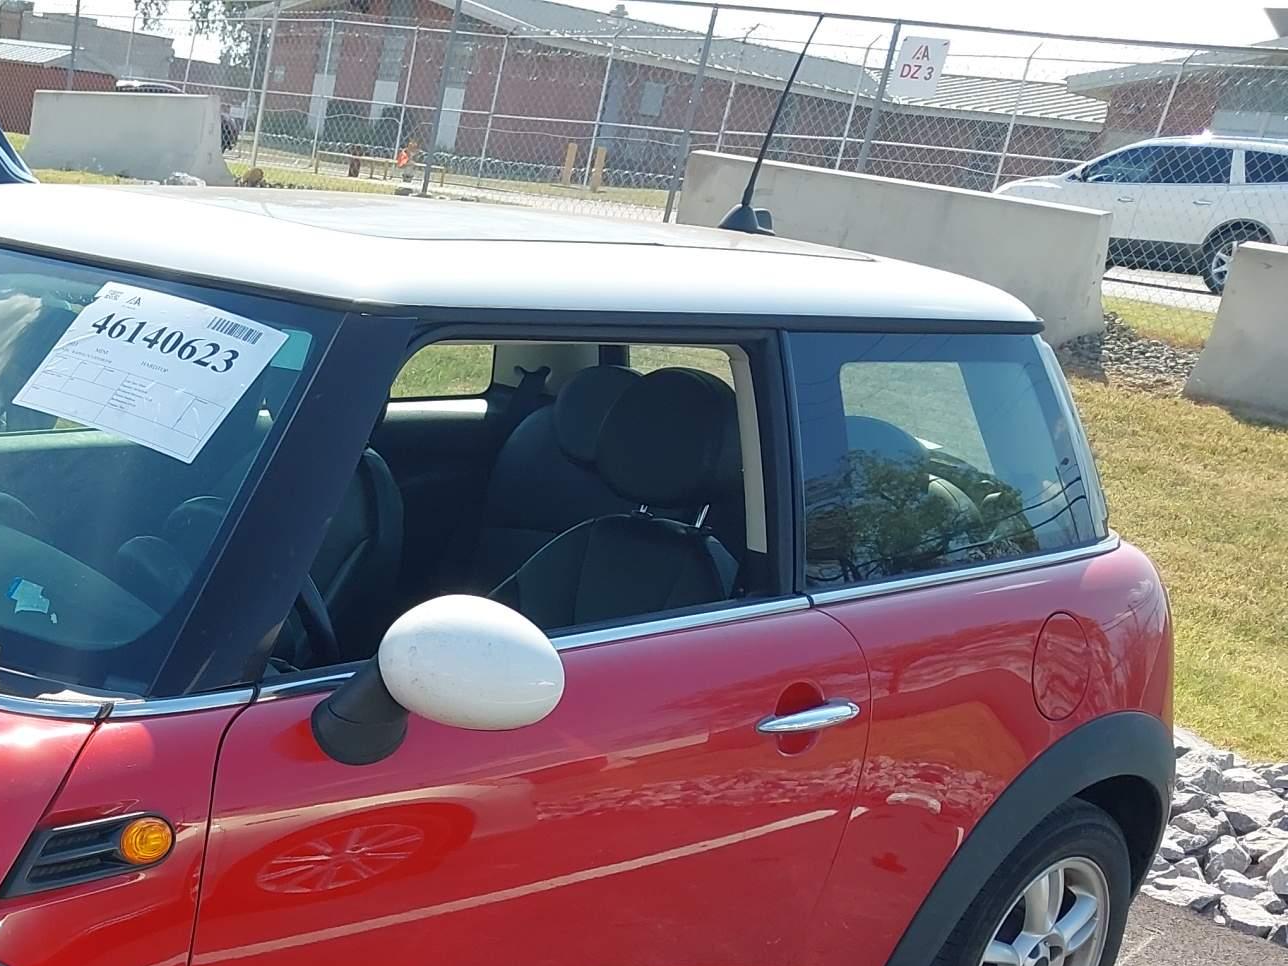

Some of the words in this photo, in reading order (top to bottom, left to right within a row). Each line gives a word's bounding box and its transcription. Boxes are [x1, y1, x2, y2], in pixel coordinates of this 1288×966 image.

[900, 63, 922, 79] DZ
[924, 66, 934, 80] 3
[92, 313, 239, 373] 46140623
